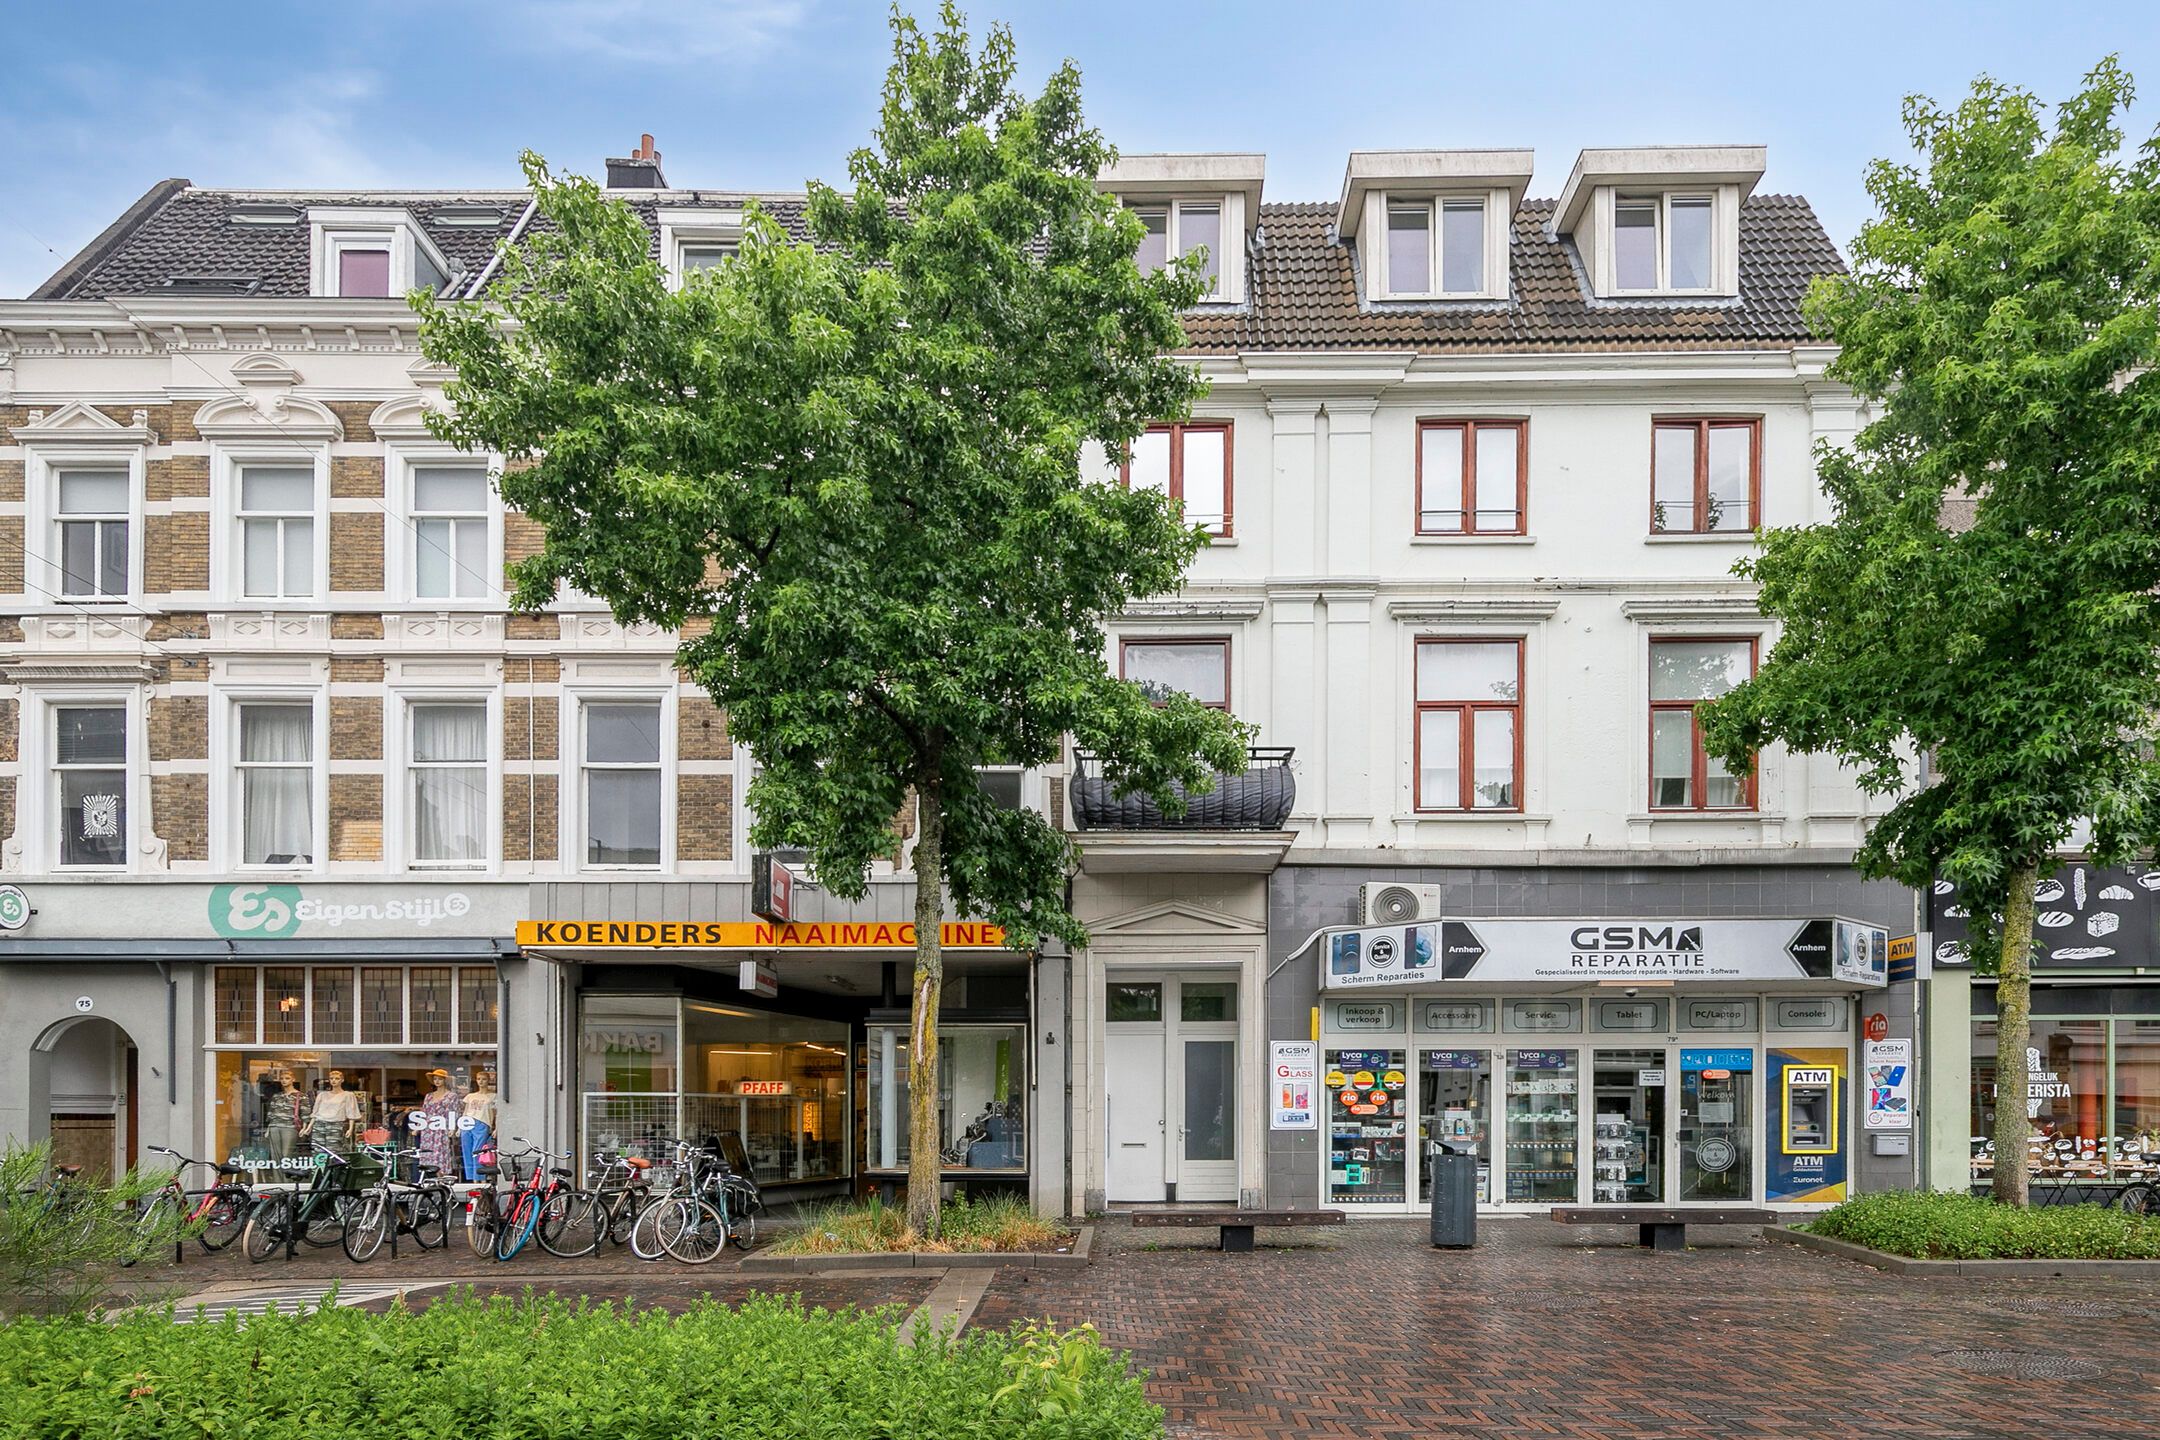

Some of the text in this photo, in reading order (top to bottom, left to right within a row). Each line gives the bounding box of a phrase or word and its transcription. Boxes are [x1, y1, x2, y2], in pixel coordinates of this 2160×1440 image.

[295, 899, 384, 926] Eigen
[385, 898, 447, 926] Stijl
[537, 923, 1006, 944] KOENDERS NAAIMACINE
[1571, 927, 1672, 950] GSM
[1891, 941, 1913, 957] ATM
[1572, 955, 1704, 966] REPARATIE
[1341, 971, 1425, 984] Scherm Reparaties
[1346, 1008, 1375, 1017] Inkoop
[1431, 1011, 1477, 1019] Accessoire
[1695, 1010, 1741, 1020] PC/Laptop
[1788, 1010, 1827, 1018] Consoles
[1346, 1016, 1381, 1024] verkoop
[1871, 1016, 1886, 1031] ria
[1342, 1052, 1362, 1060] Lyca
[1432, 1052, 1452, 1060] Lyca
[1519, 1052, 1540, 1060] Lyca
[1794, 1072, 1827, 1082] ATM
[743, 1083, 783, 1094] PFAFF
[408, 1111, 475, 1131] Sale
[281, 1155, 317, 1171] Stijl
[1793, 1156, 1823, 1166] ATM
